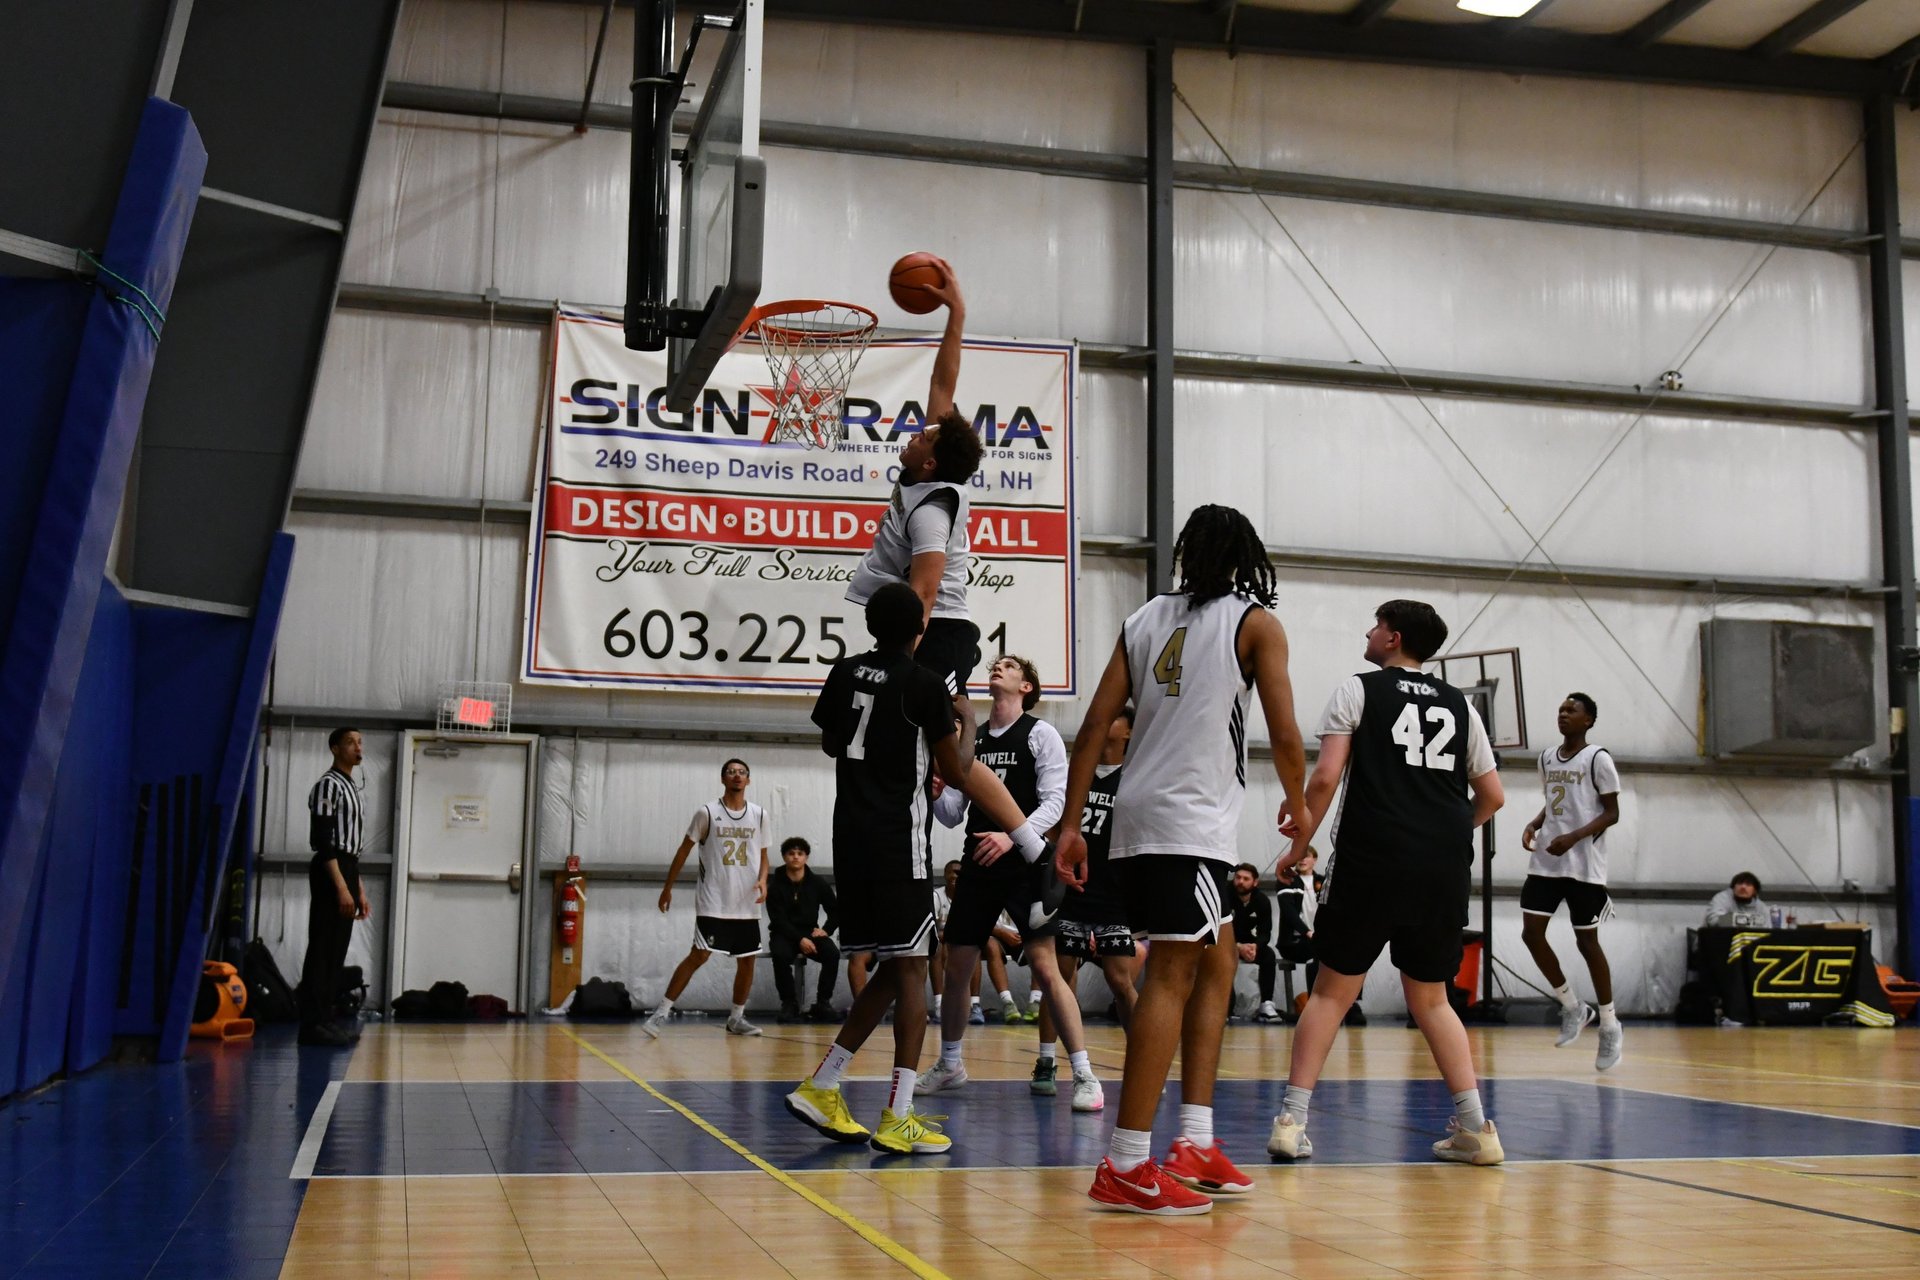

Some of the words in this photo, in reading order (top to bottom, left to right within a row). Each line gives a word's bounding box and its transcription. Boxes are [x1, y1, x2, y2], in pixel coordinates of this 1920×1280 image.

[571, 378, 750, 436] SIGN
[595, 449, 637, 469] 249
[645, 453, 720, 480] Sheep
[728, 458, 794, 480] Davis
[803, 462, 864, 483] Road
[1000, 470, 1033, 490] NH
[837, 444, 880, 453] WHERE
[991, 450, 1015, 459] FOR
[1018, 451, 1053, 461] SIGNS
[571, 496, 718, 535] DESIGN
[743, 507, 859, 541] BUILD
[595, 539, 676, 583] Your
[683, 546, 752, 578] Full
[757, 549, 853, 582] Service
[1152, 626, 1188, 697] 4
[846, 690, 875, 761] 7
[1391, 702, 1456, 772] 42
[974, 752, 1018, 766] OWELL
[1551, 785, 1566, 816] 2
[716, 825, 757, 839] LEGACY
[722, 840, 748, 867] 24
